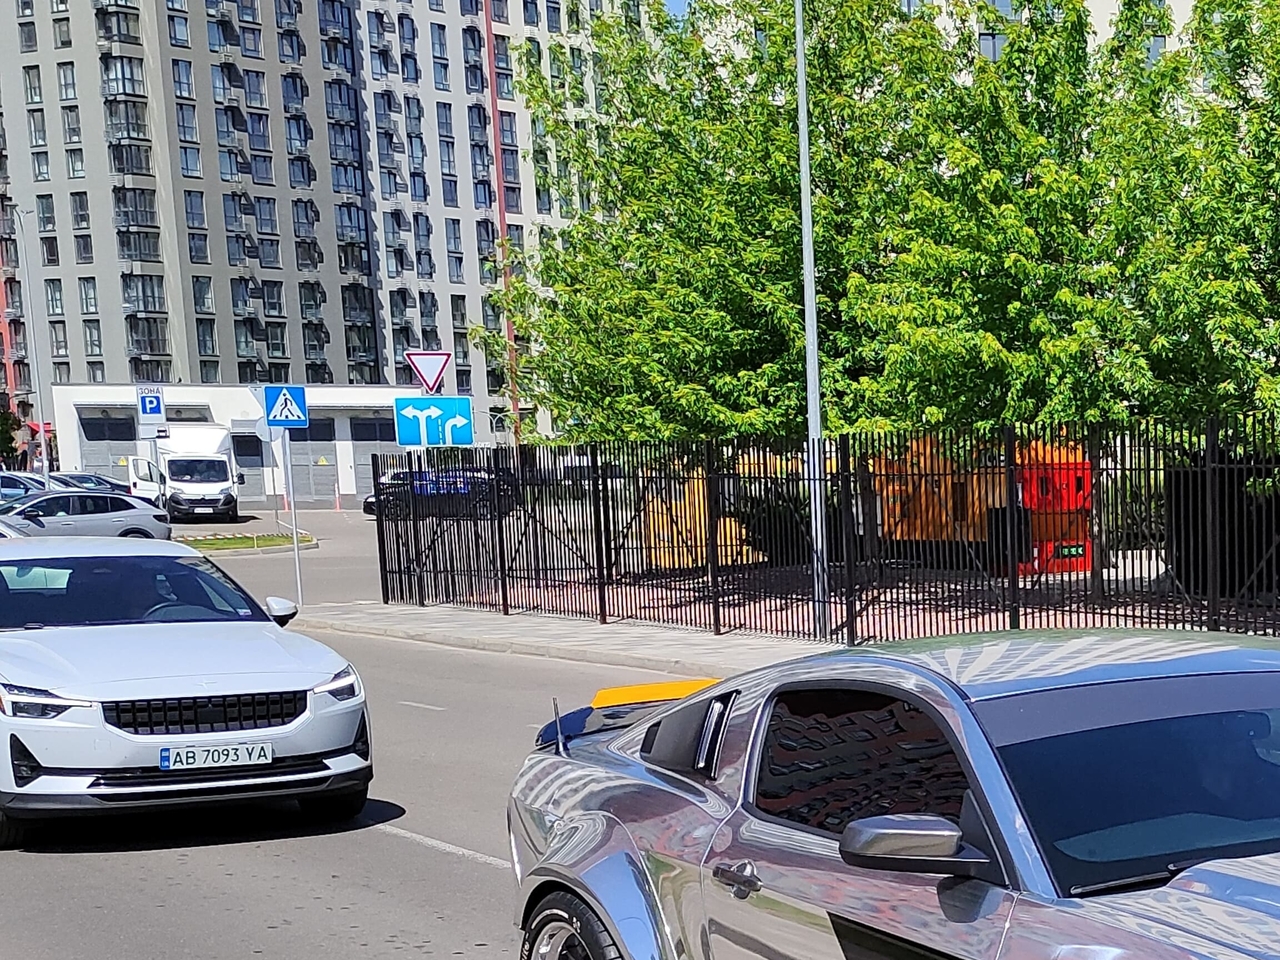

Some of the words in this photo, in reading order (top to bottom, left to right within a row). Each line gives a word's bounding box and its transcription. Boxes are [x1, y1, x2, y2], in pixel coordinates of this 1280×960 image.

[139, 387, 161, 395] ЗОНА
[145, 397, 158, 414] P
[172, 751, 196, 767] AB
[202, 748, 239, 764] 7093
[246, 745, 268, 761] YA
